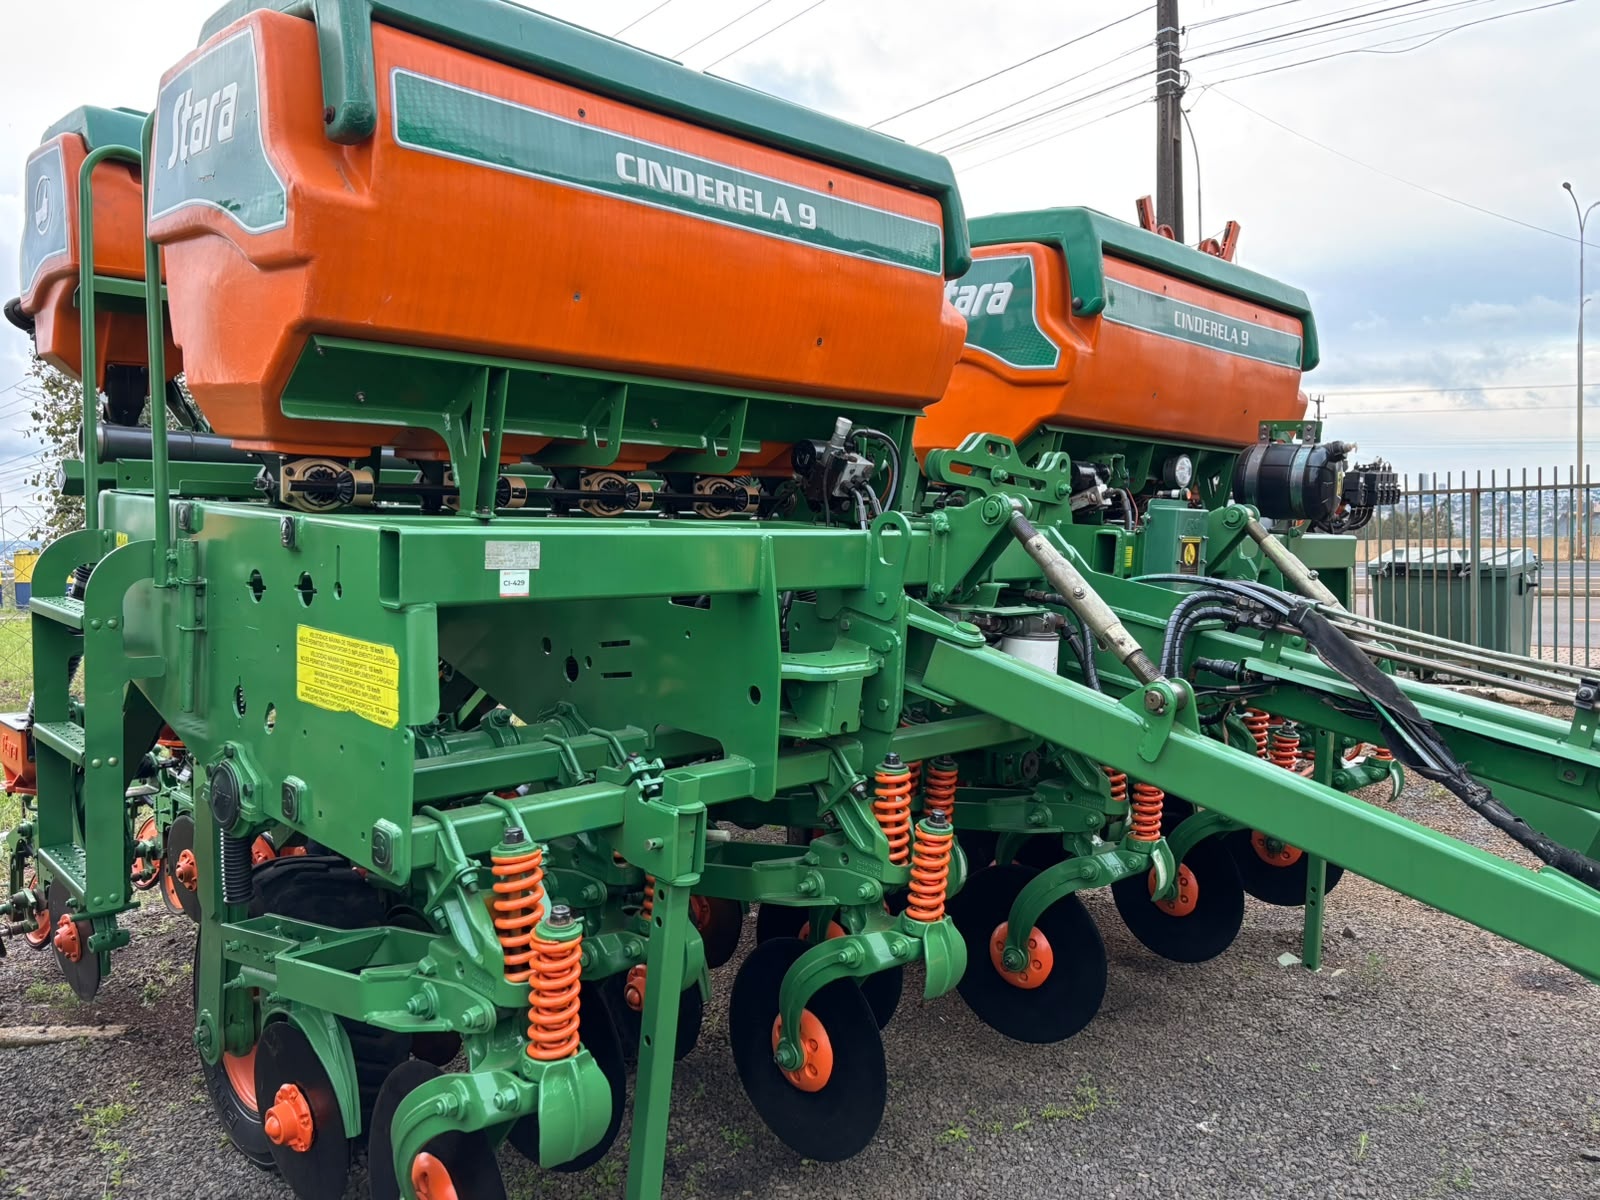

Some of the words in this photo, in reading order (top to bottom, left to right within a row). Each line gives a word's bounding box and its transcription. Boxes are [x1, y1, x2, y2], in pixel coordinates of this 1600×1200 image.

[167, 81, 238, 170] Stara
[615, 152, 792, 224] CINDERELA
[798, 203, 817, 230] 9
[944, 280, 1014, 317] tara
[1174, 310, 1239, 345] CINDERELA
[1241, 331, 1249, 346] 9
